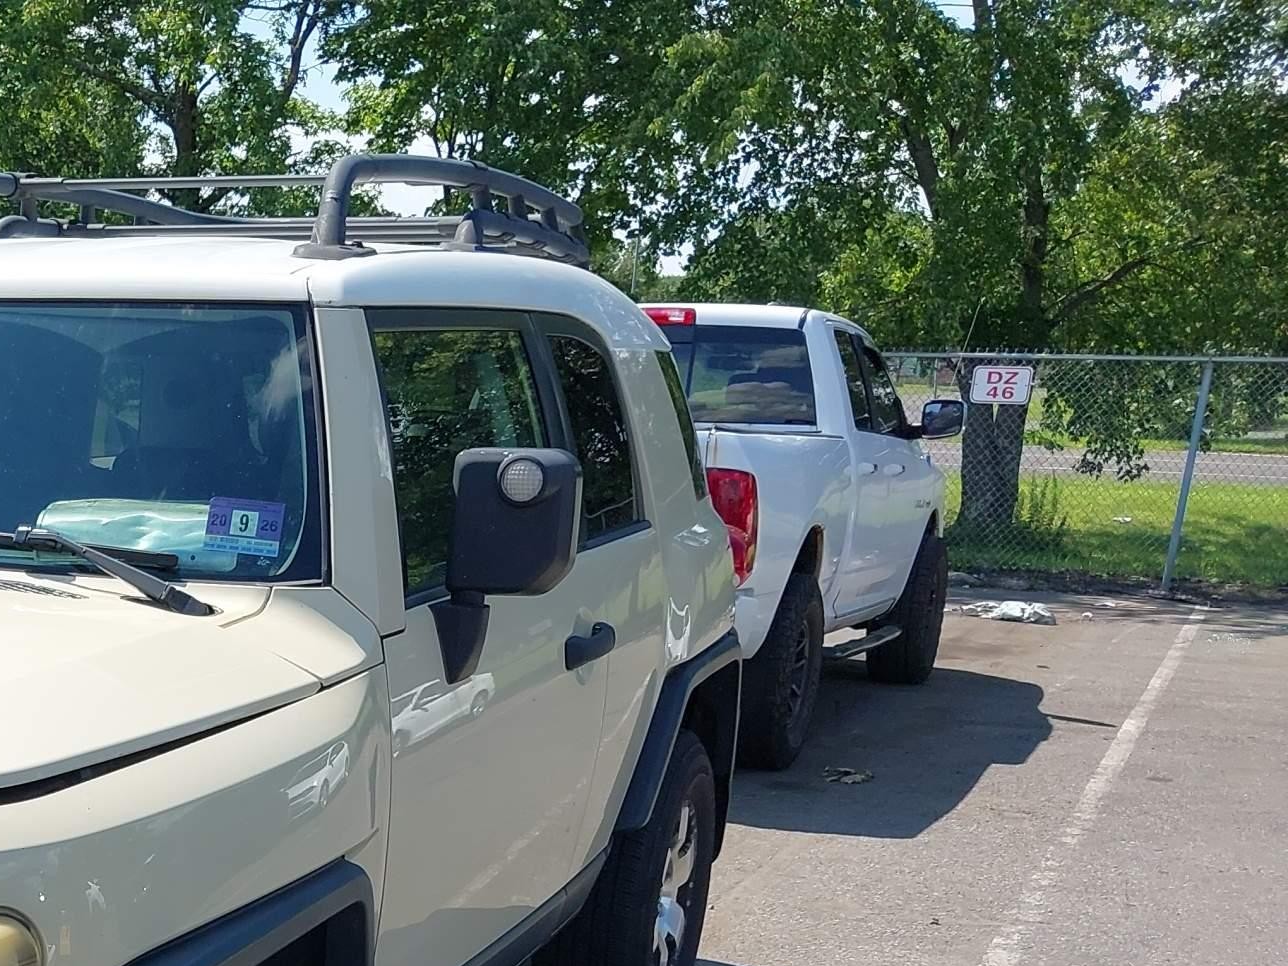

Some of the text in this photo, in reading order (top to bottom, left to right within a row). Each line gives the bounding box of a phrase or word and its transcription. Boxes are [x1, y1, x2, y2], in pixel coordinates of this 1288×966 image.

[986, 371, 1019, 385] DZ
[986, 386, 1015, 400] 46
[210, 513, 279, 532] 20 9 26
